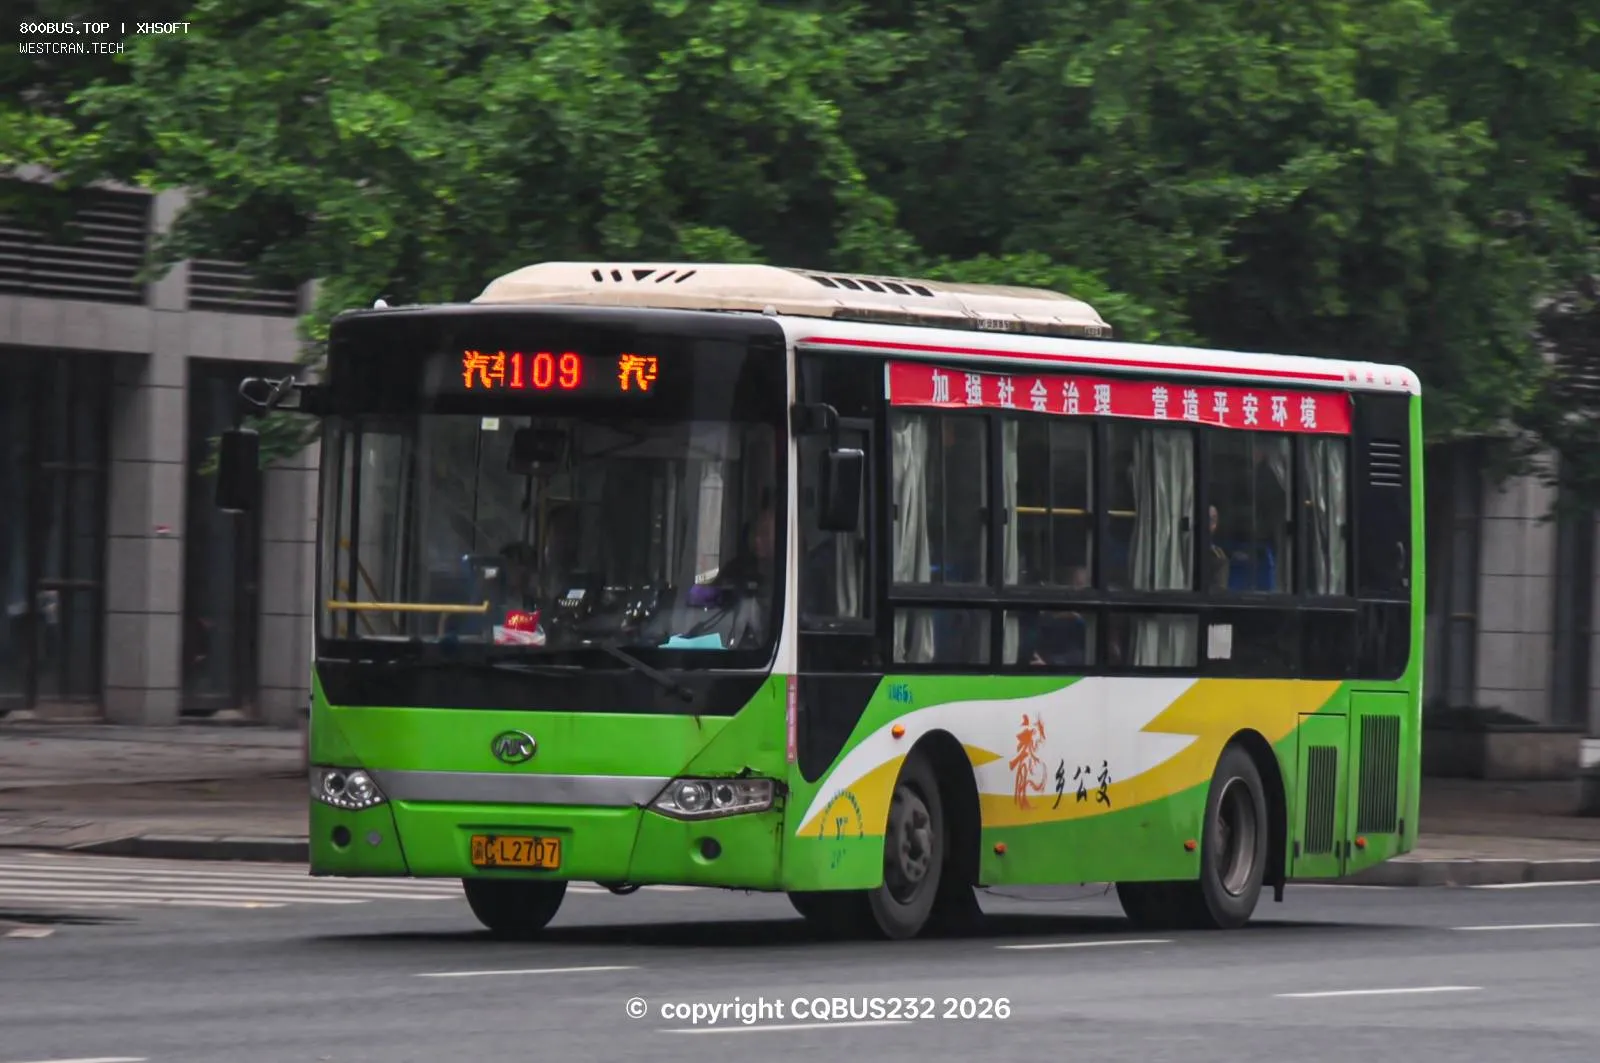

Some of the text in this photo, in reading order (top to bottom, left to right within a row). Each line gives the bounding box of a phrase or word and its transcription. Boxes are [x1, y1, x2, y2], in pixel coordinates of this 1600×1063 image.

[509, 352, 580, 388] 109
[932, 368, 1317, 429] 加强社会治理 营造平安环境
